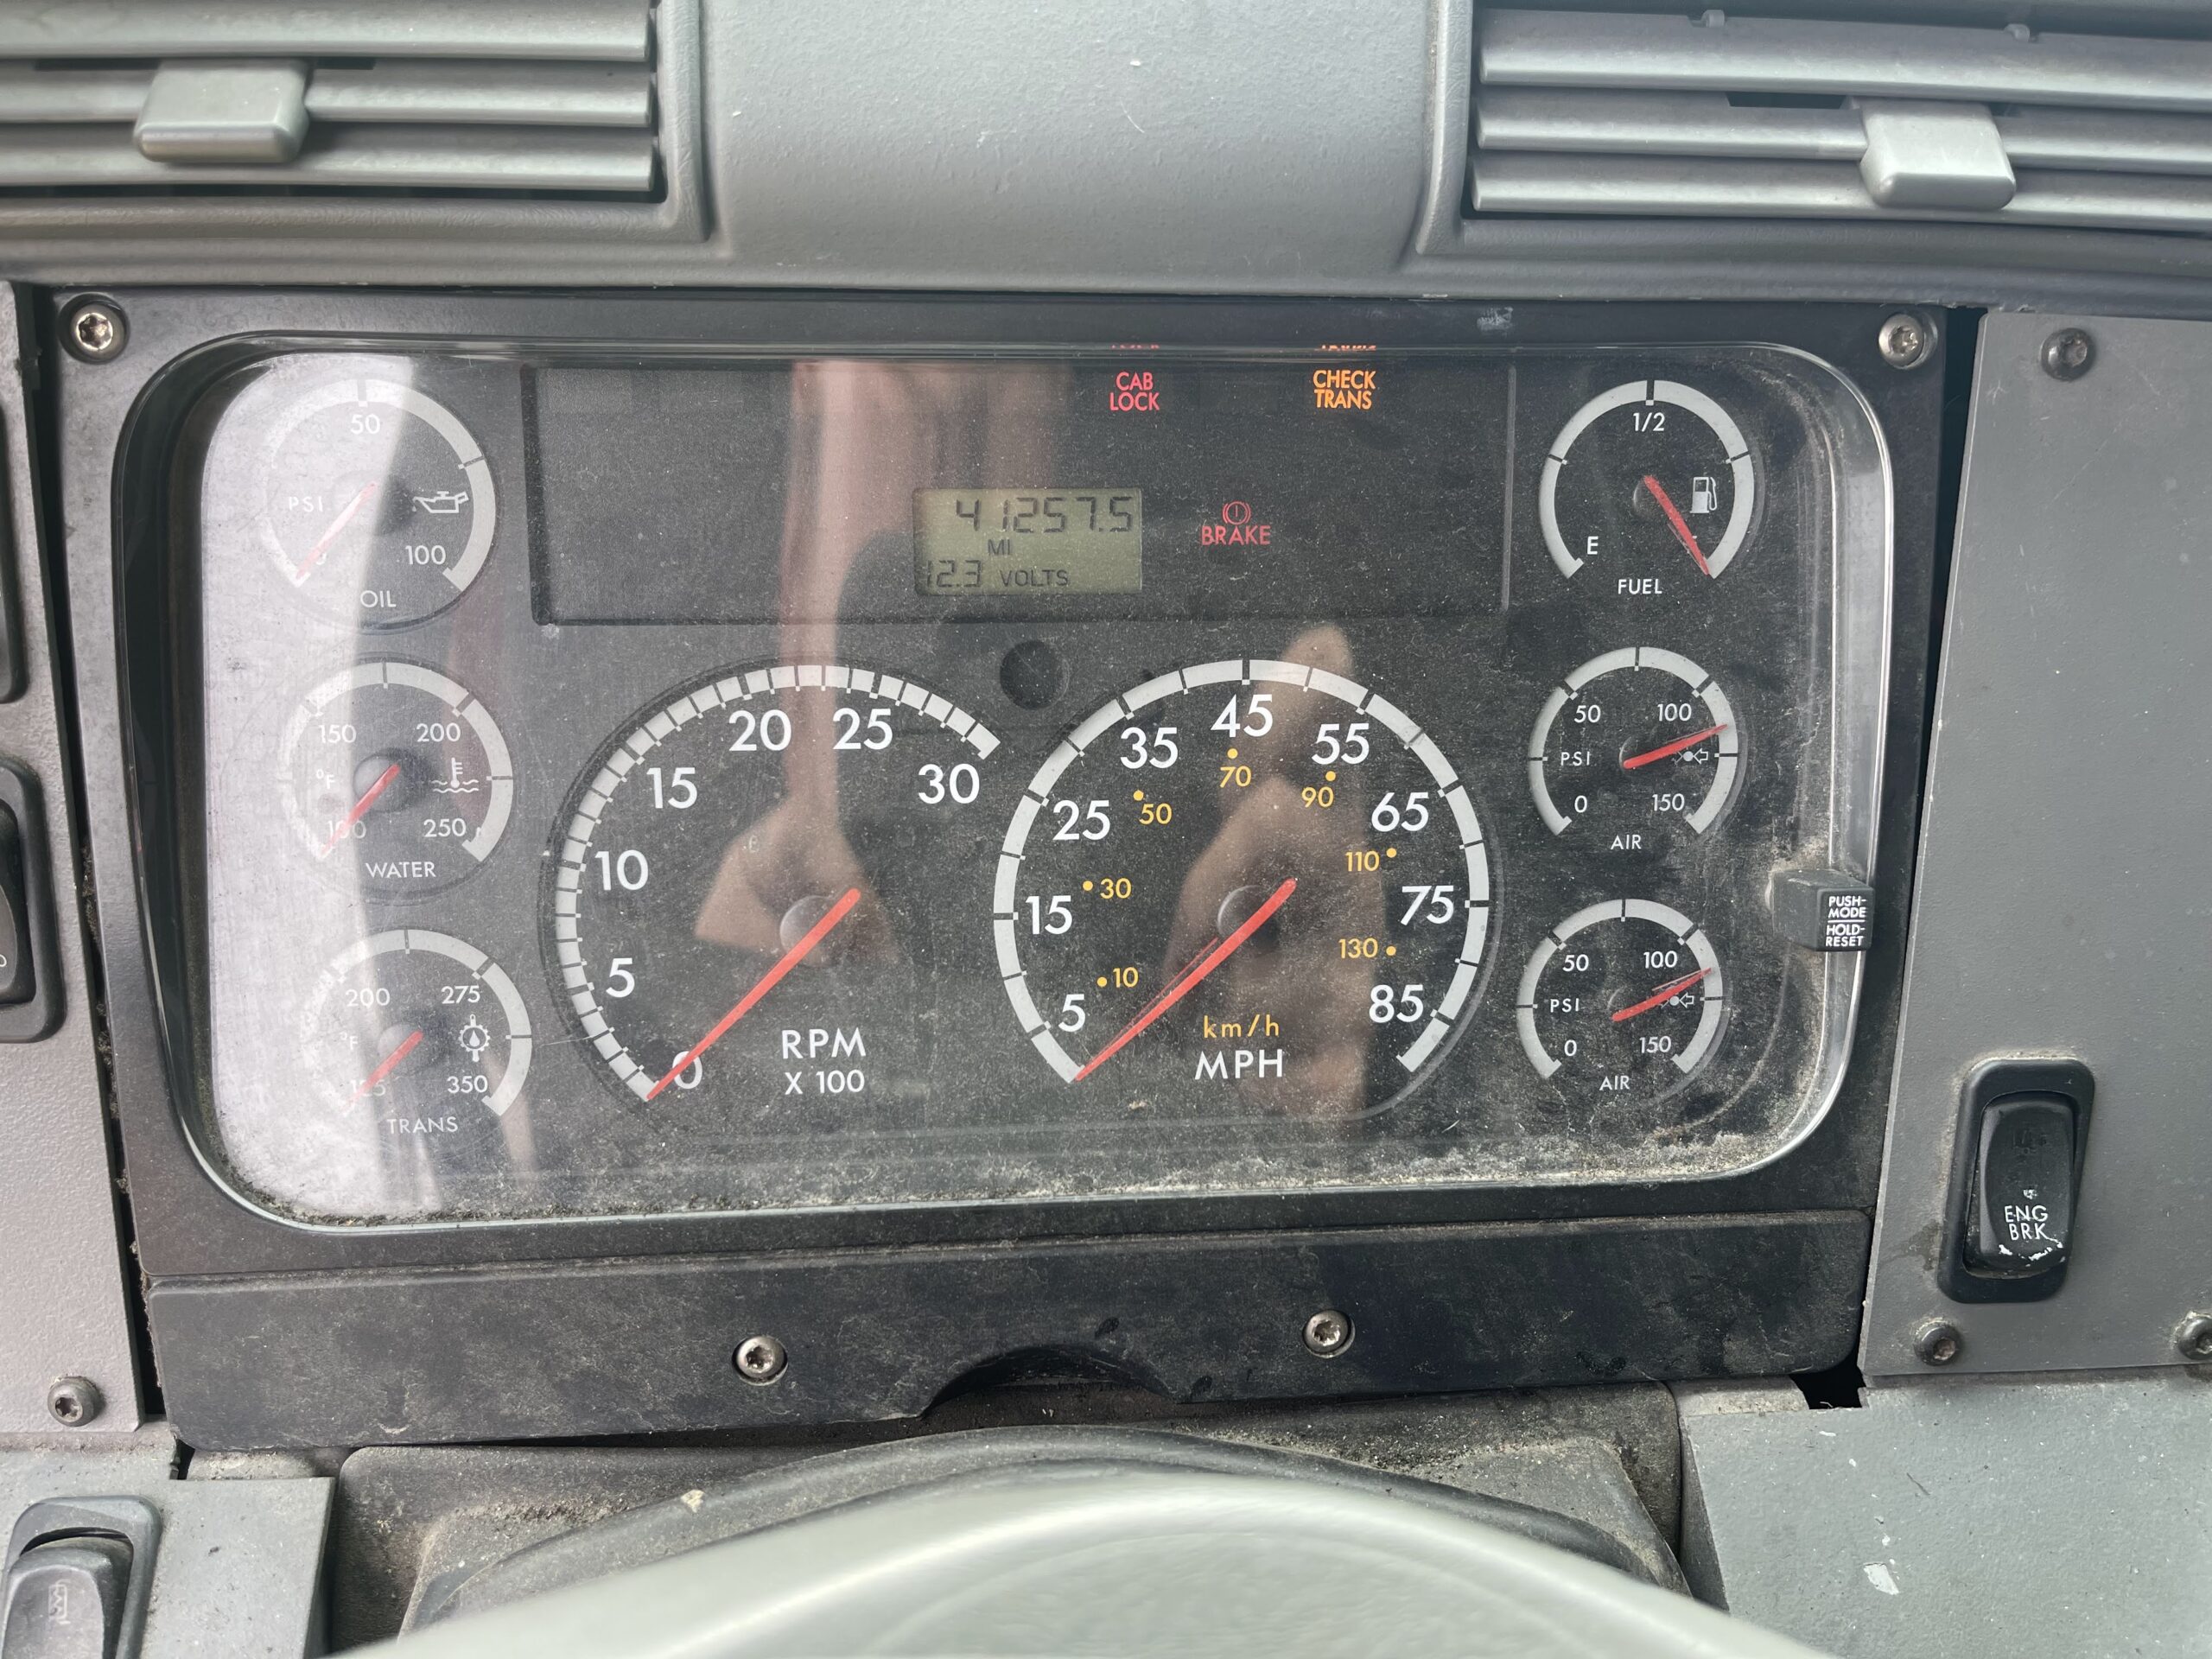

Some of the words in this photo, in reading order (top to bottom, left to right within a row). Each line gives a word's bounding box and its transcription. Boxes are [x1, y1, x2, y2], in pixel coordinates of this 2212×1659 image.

[1116, 372, 1154, 391] CAB
[1313, 370, 1376, 390] CHECK
[1109, 392, 1160, 411] LOCK
[1314, 390, 1372, 410] TRANS
[350, 414, 380, 435] 50
[1633, 412, 1665, 432] 1/2
[288, 496, 323, 512] PSI
[1201, 525, 1271, 545] BRAKE
[405, 545, 446, 564] 100
[988, 538, 1012, 556] MI
[1586, 536, 1599, 555] E
[1000, 569, 1069, 587] VOLTS
[1618, 579, 1662, 594] FUEL
[359, 590, 396, 608] OIL
[1211, 694, 1274, 737] 45
[1574, 705, 1601, 723] 50
[1656, 703, 1692, 721] 100
[319, 724, 356, 743] 150
[416, 722, 461, 742] 200
[728, 710, 791, 752] 20
[832, 709, 893, 750] 25
[1120, 728, 1179, 769] 35
[1312, 723, 1370, 766] 55
[1560, 752, 1591, 766] PSI
[918, 763, 980, 804] 30
[1219, 766, 1252, 788] 70
[646, 766, 698, 809] 15
[1301, 787, 1334, 808] 90
[1371, 791, 1429, 832] 65
[1574, 795, 1587, 813] 0
[1652, 794, 1685, 811] 150
[1052, 799, 1110, 841] 25
[1139, 804, 1172, 825] 50
[423, 817, 466, 837] 250
[1611, 835, 1642, 850] AIR
[365, 861, 436, 877] WATER
[594, 849, 649, 891] 10
[1345, 851, 1380, 873] 110
[1100, 878, 1132, 899] 30
[1400, 885, 1455, 926] 75
[1829, 895, 1866, 907] PUSH-
[1025, 894, 1073, 935] 15
[1827, 906, 1866, 918] MODE
[1826, 924, 1866, 936] HOLD-
[1338, 938, 1378, 959] 130
[1825, 936, 1864, 947] RESET
[1563, 954, 1589, 972] 50
[1643, 951, 1677, 969] 100
[606, 957, 635, 998] 5
[1112, 967, 1139, 988] 10
[346, 988, 391, 1007] 200
[441, 985, 480, 1004] 275
[1369, 984, 1424, 1024] 85
[1058, 994, 1085, 1033] 5
[1550, 998, 1580, 1013] PSI
[1203, 1014, 1280, 1039] km/h
[782, 1027, 867, 1058] RPM
[1564, 1039, 1577, 1058] 0
[1639, 1036, 1671, 1053] 150
[671, 1051, 703, 1090] 0
[1195, 1049, 1283, 1080] MPH
[447, 1075, 488, 1094] 350
[785, 1071, 803, 1095] X
[816, 1070, 865, 1093] 100
[1599, 1076, 1630, 1090] AIR
[387, 1116, 458, 1134] TRANS
[2005, 1205, 2048, 1223] ENG
[2009, 1223, 2047, 1241] BRK
